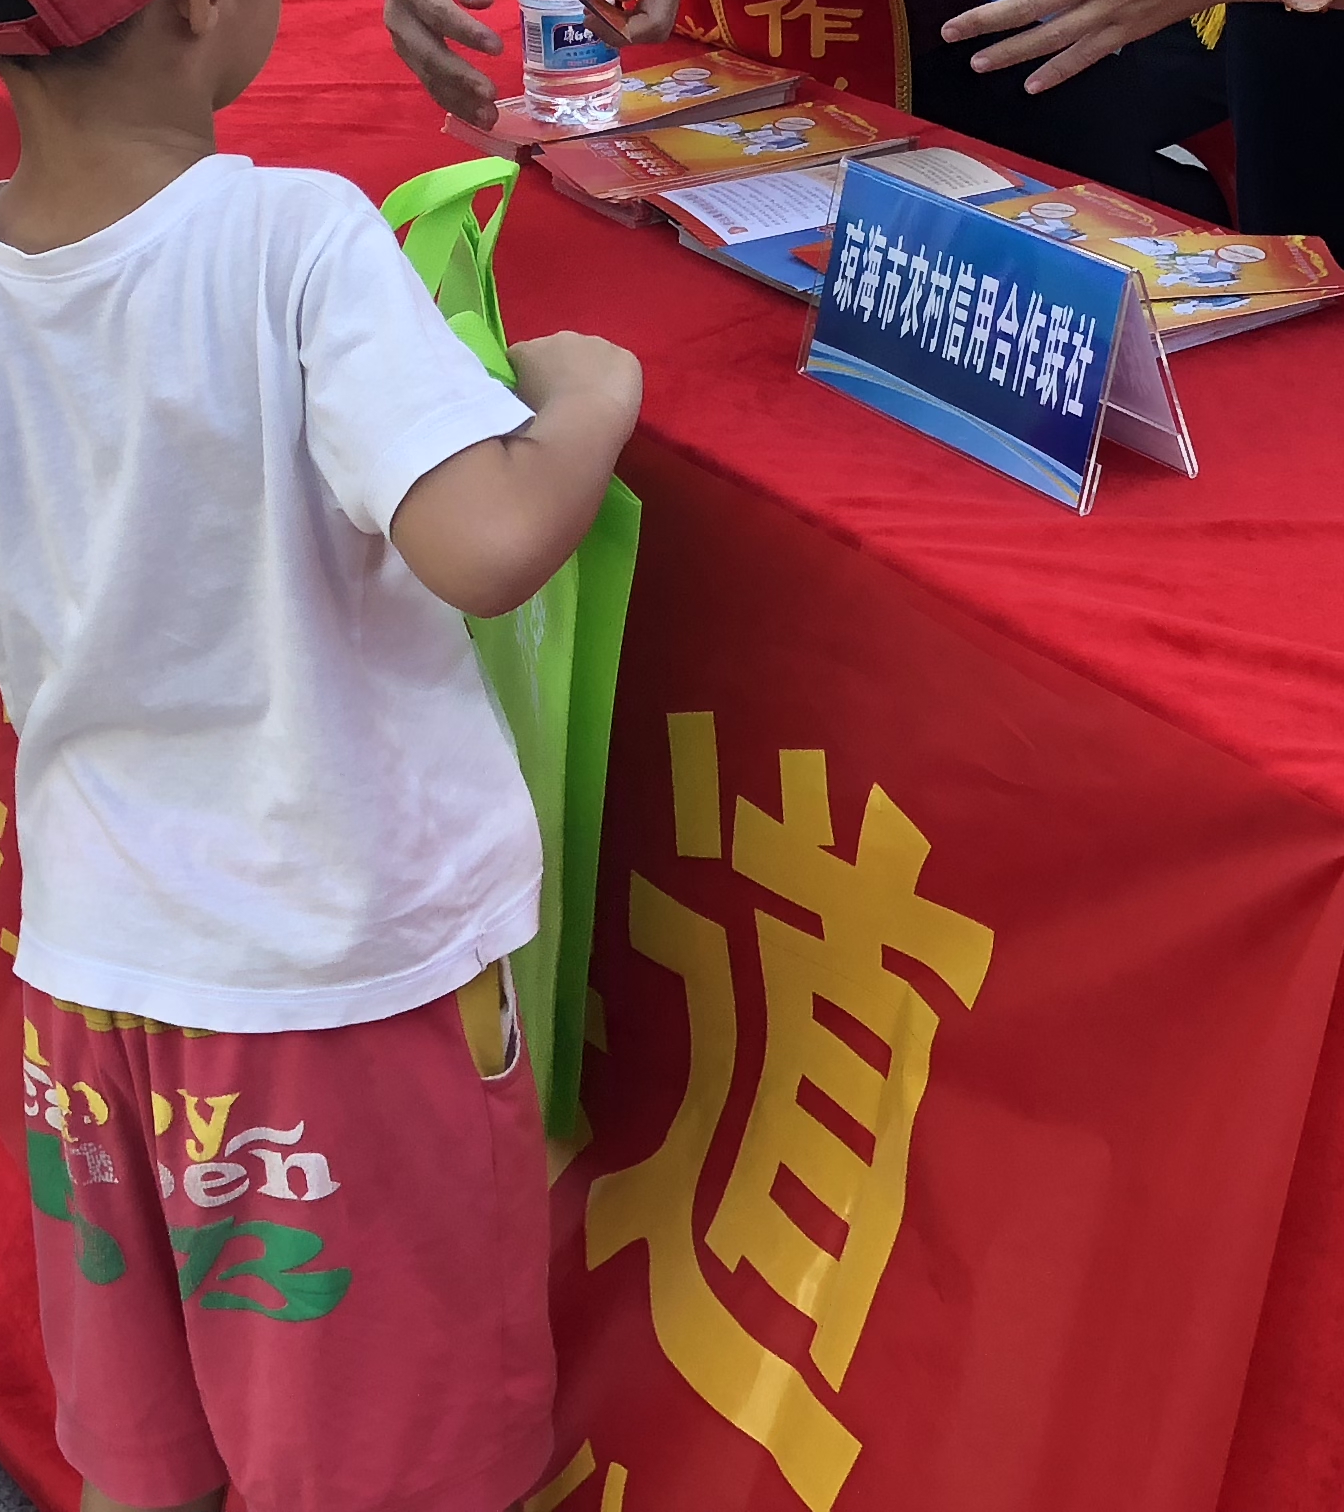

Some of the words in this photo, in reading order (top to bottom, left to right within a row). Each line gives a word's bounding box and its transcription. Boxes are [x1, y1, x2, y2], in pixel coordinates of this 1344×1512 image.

[832, 218, 1097, 418] 琼海市农村信用合作联社
[585, 711, 994, 1512] 道
